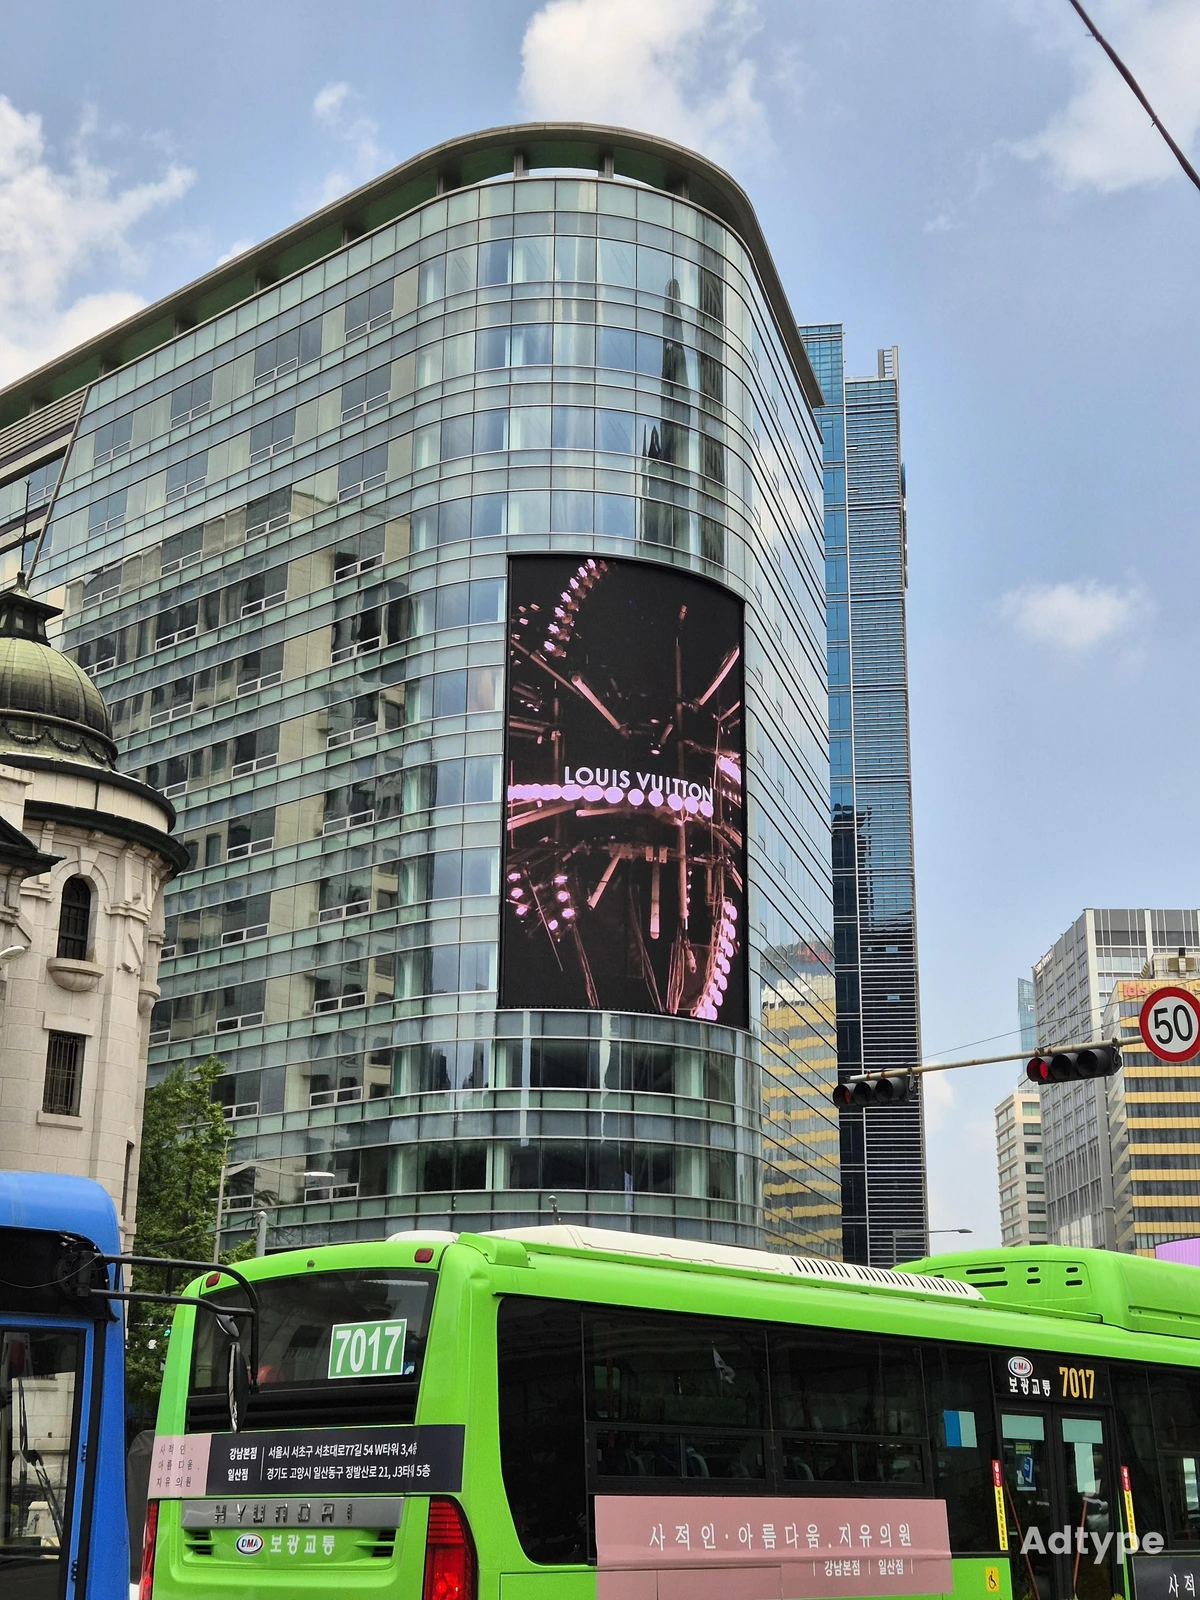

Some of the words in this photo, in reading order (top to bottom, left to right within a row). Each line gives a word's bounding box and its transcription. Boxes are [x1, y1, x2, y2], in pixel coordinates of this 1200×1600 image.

[565, 766, 630, 789] LOUIS
[637, 771, 713, 806] VUITTON
[1154, 1005, 1193, 1044] 50
[336, 1326, 402, 1373] 7017
[1013, 1362, 1028, 1370] DMA
[1009, 1377, 1051, 1397] 보광교통
[1059, 1366, 1095, 1400] 7017
[229, 1447, 257, 1460] 강남본점
[268, 1446, 290, 1459] 서울시
[291, 1445, 313, 1458] 서초구
[315, 1444, 362, 1458] 서초대로77길
[363, 1445, 374, 1456] 54
[228, 1468, 249, 1481] 일산점
[267, 1467, 288, 1480] 경기도
[289, 1466, 311, 1480] 고양시
[313, 1466, 344, 1480] 일산동구
[345, 1465, 377, 1479] 정발산로
[416, 1464, 431, 1478] 5층
[215, 1503, 353, 1523] HYUNDAI
[241, 1539, 259, 1549] DMA
[270, 1534, 335, 1555] 보광교통
[825, 1560, 860, 1577] 강남본점
[879, 1559, 904, 1575] 일산점
[1168, 1572, 1196, 1599] 사적
